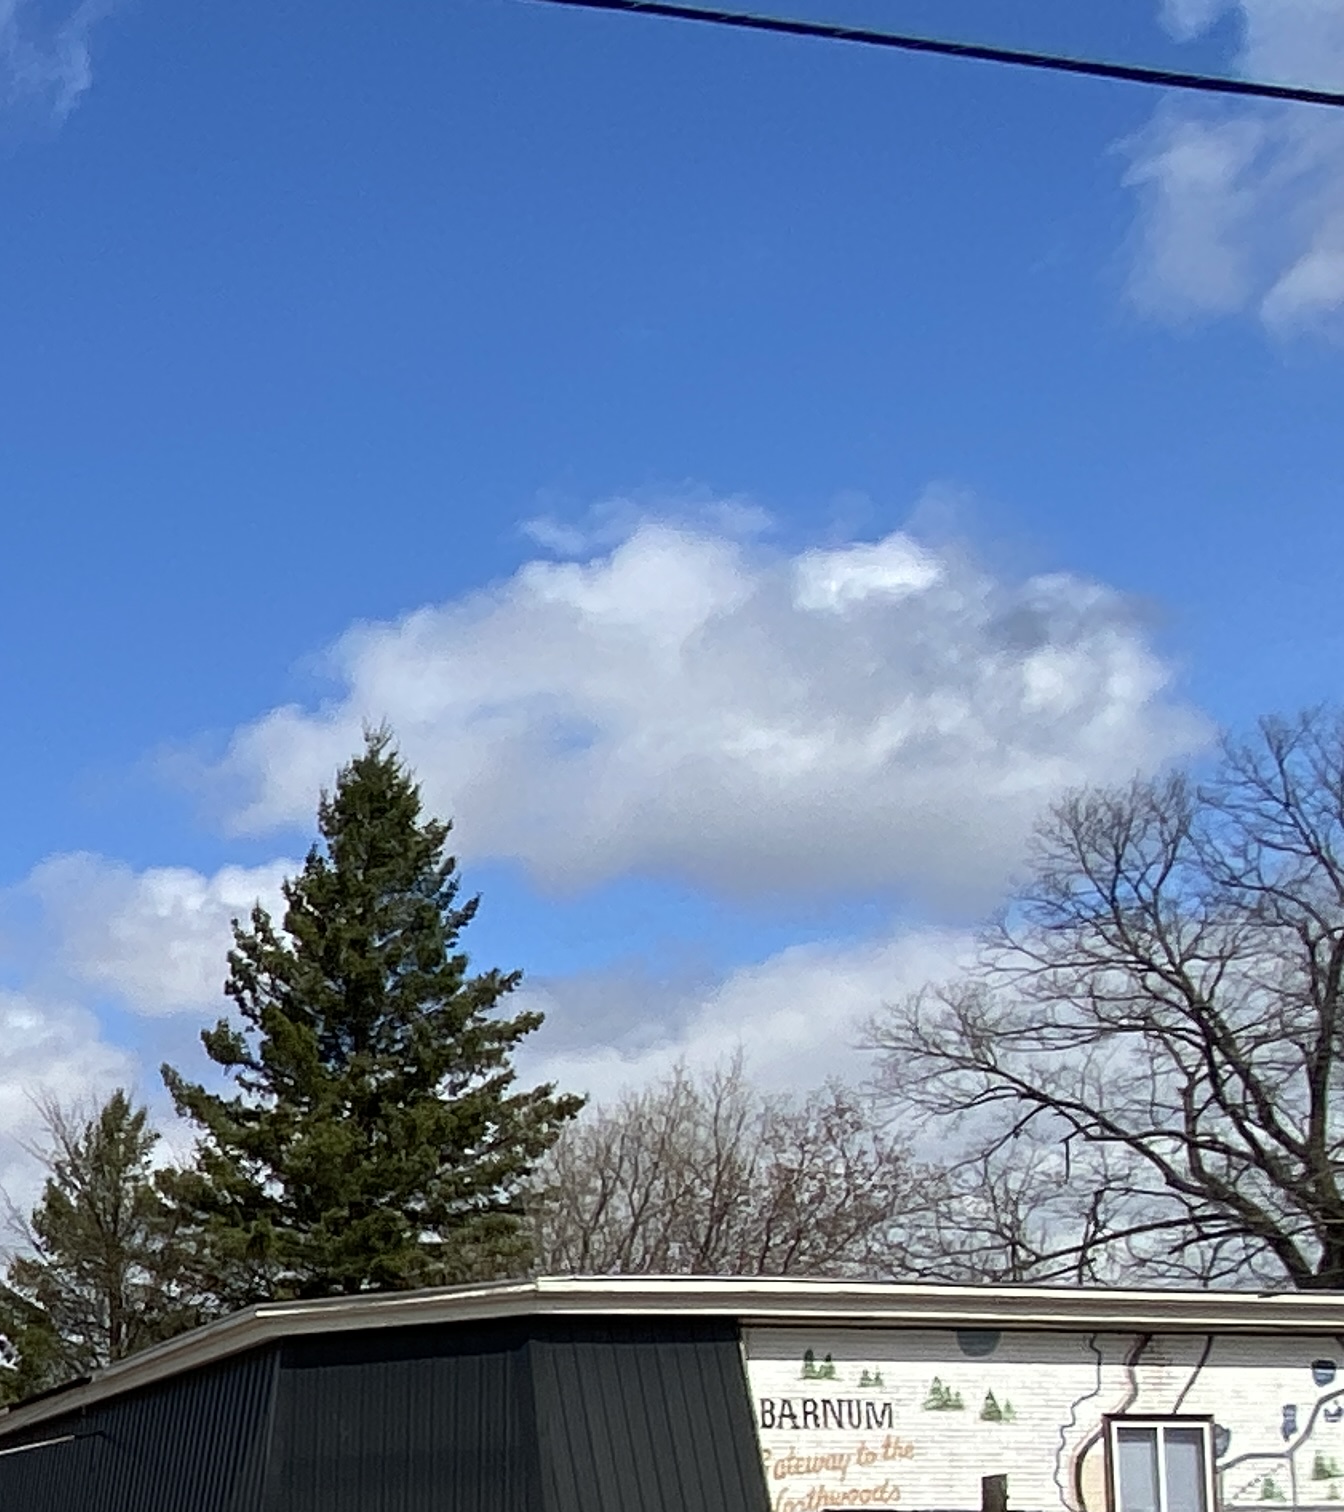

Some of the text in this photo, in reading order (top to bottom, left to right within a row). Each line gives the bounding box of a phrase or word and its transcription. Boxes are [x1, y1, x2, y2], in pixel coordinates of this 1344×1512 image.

[760, 1398, 894, 1429] BARNUM
[856, 1440, 877, 1466] to
[881, 1434, 914, 1460] the
